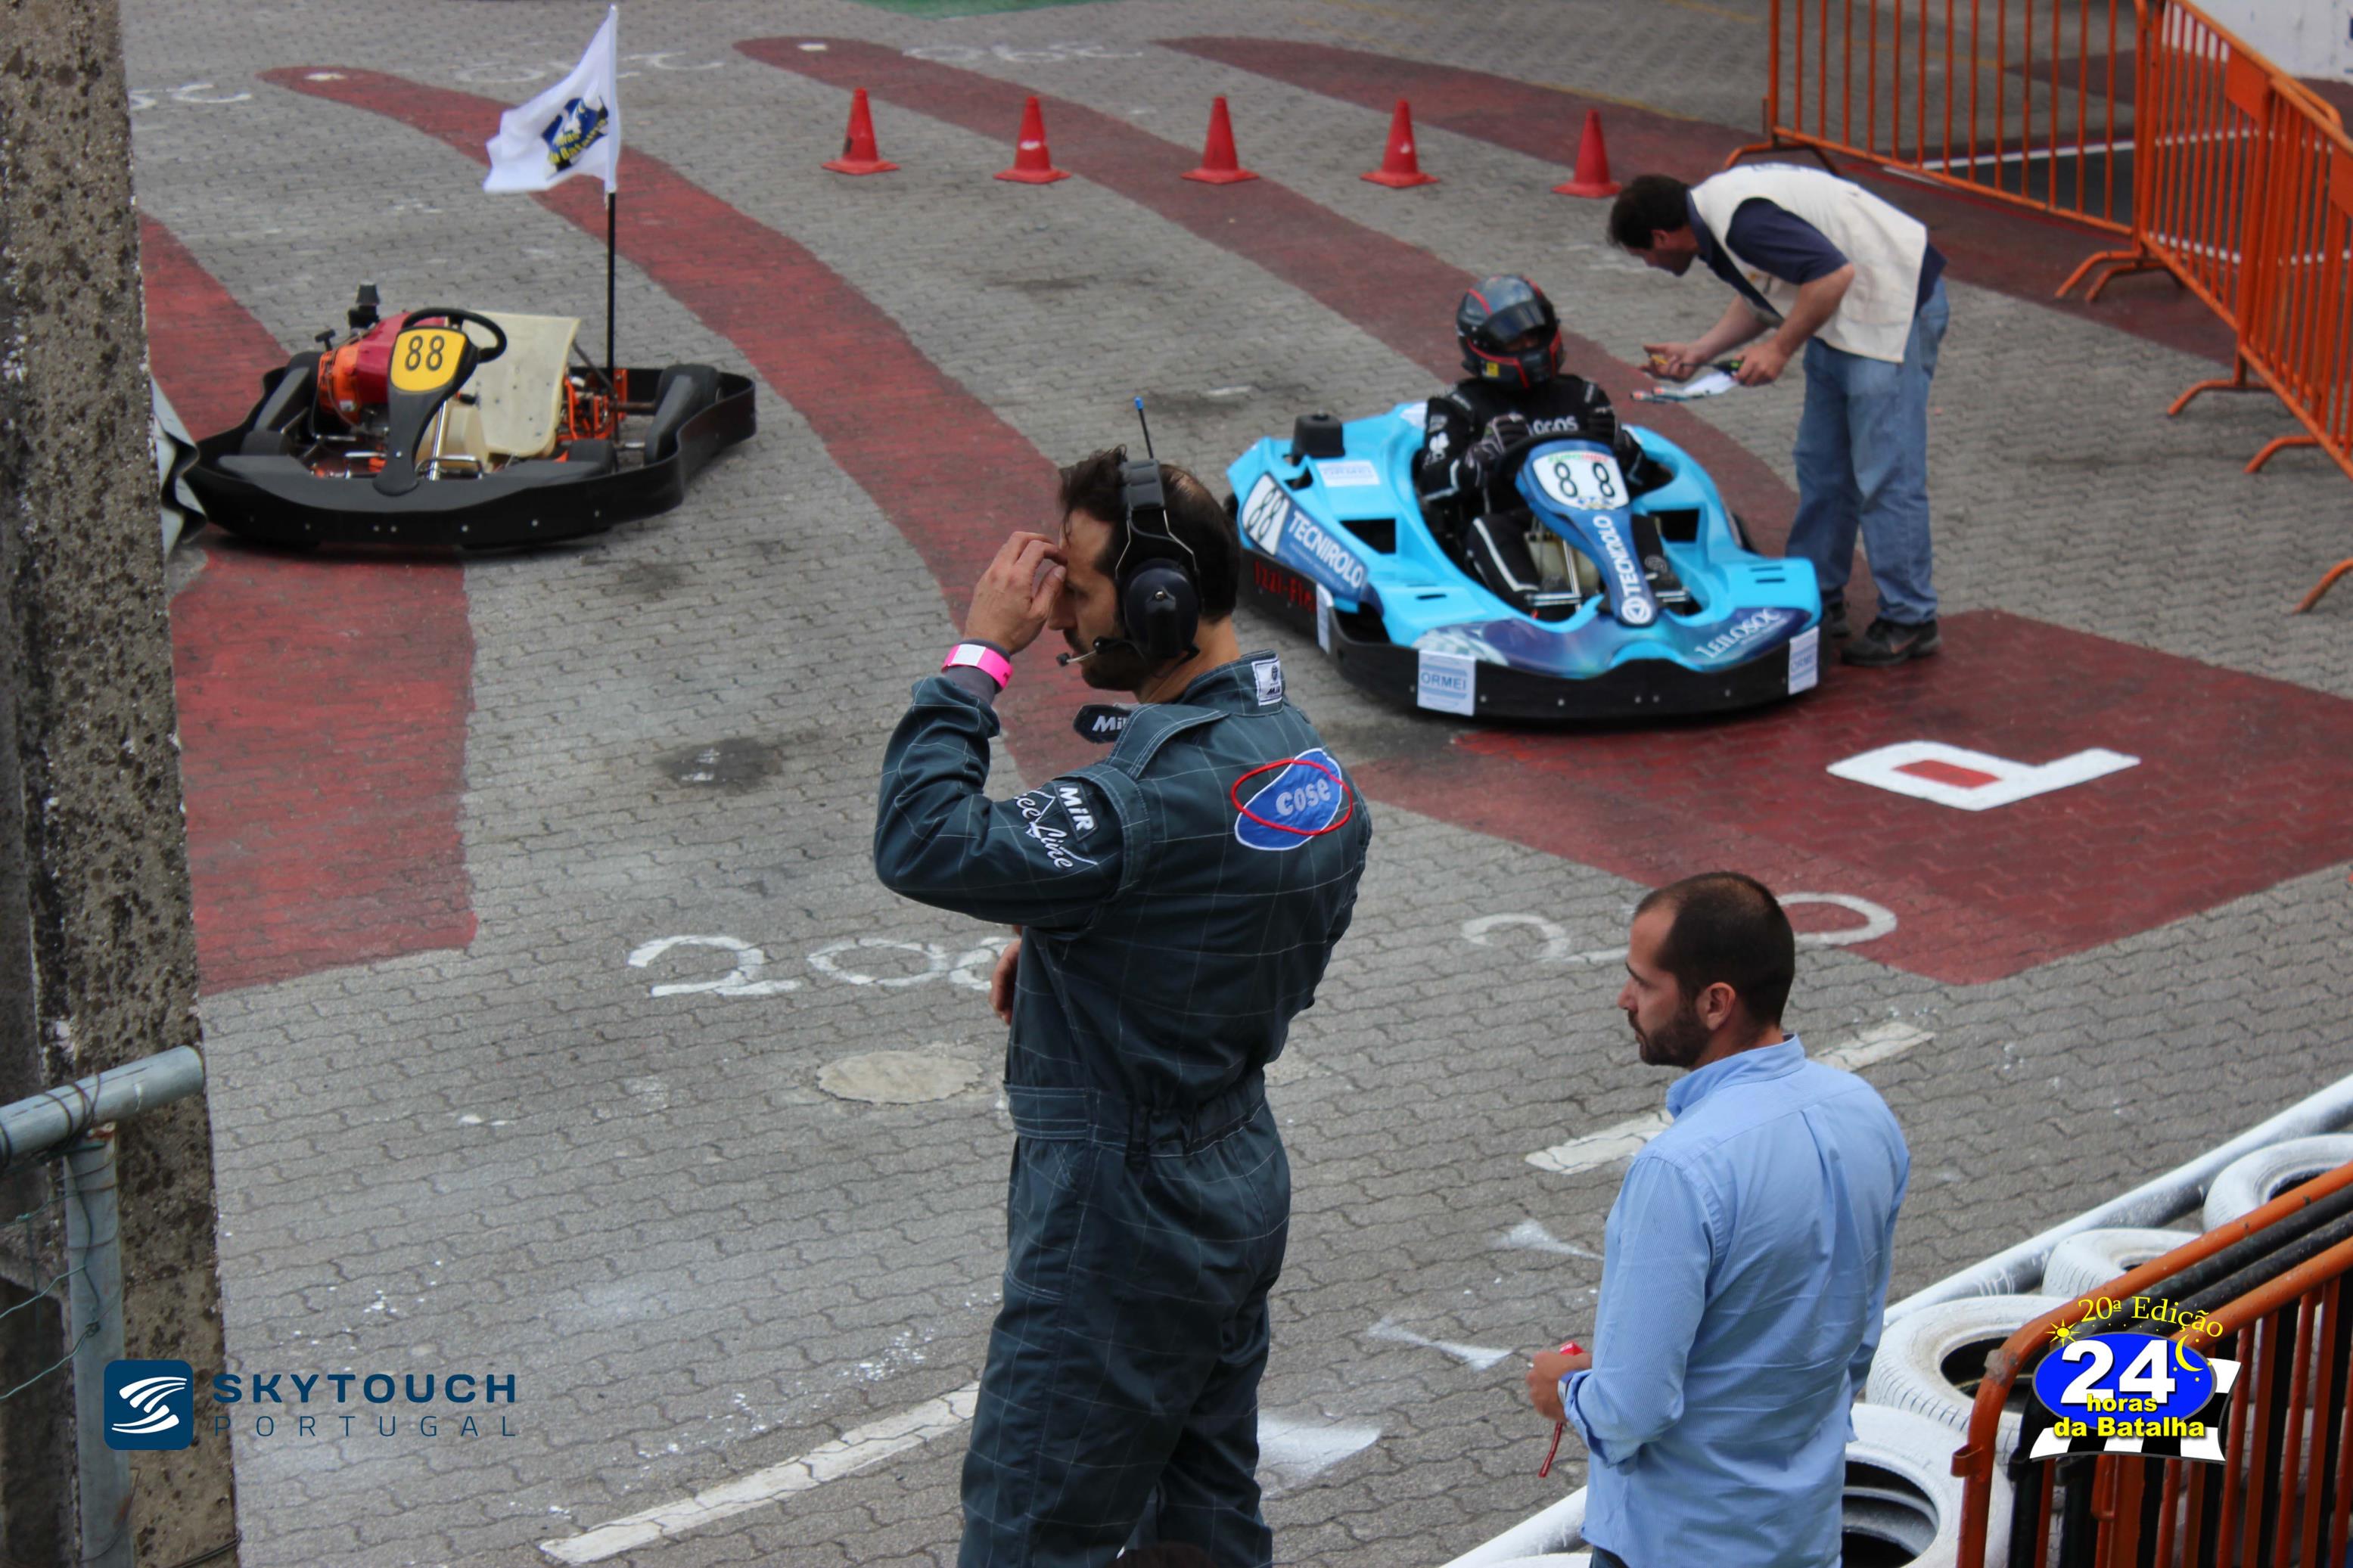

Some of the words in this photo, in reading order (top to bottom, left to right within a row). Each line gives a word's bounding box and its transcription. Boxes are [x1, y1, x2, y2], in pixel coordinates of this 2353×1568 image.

[405, 334, 446, 371] 88
[1554, 461, 1615, 498] 88
[1248, 486, 1285, 542] 88
[1288, 508, 1365, 590] TECNIROLO
